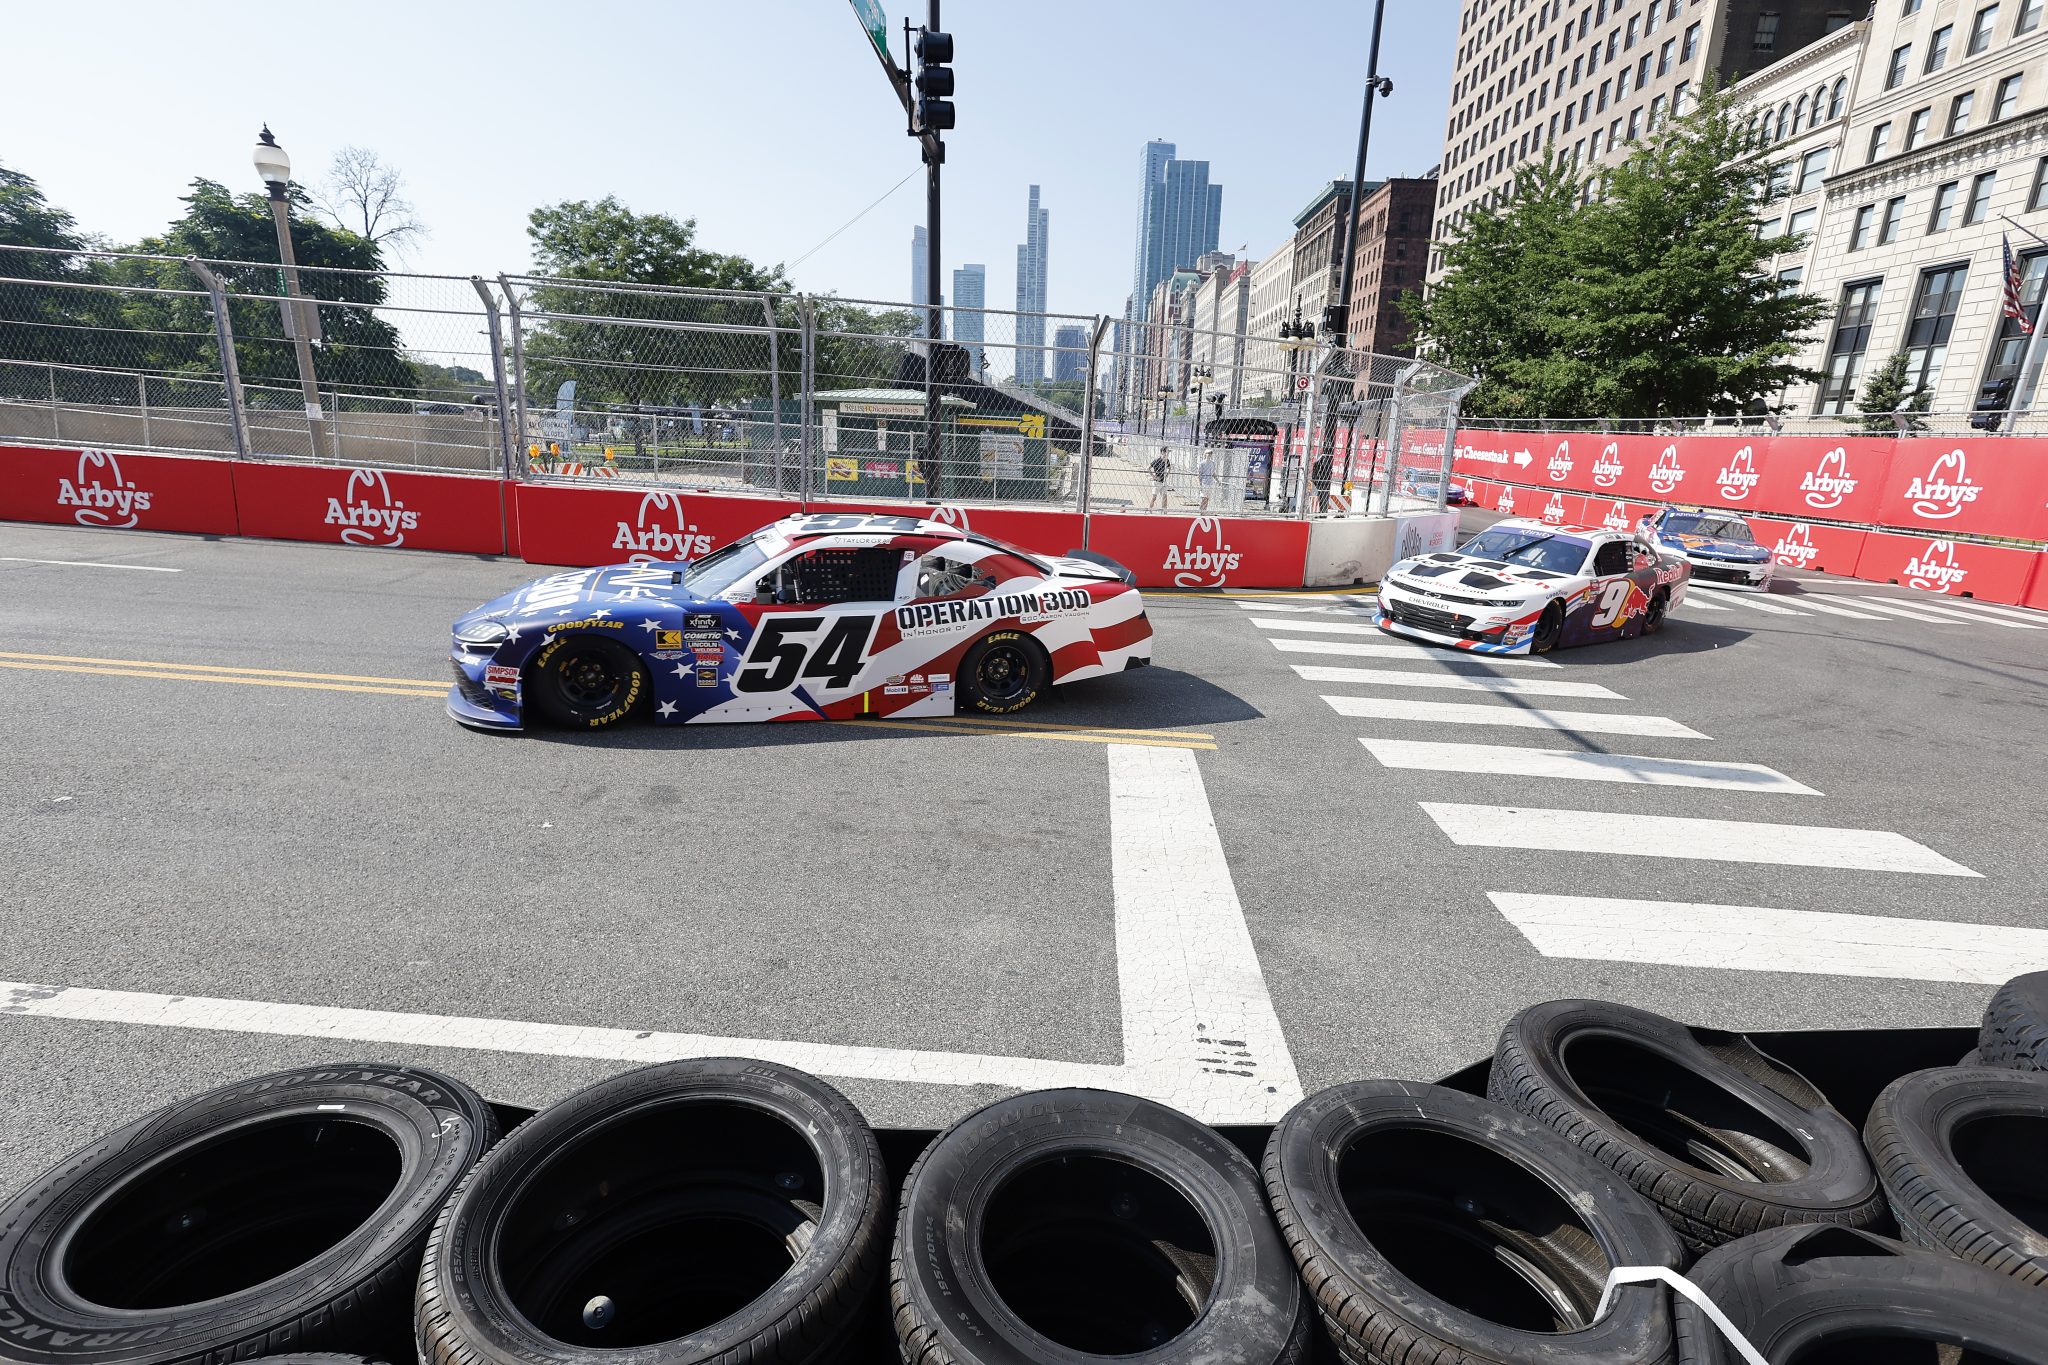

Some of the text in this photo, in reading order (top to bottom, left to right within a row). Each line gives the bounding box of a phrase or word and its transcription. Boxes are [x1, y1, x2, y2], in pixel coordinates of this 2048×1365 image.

[1463, 445, 1509, 464] Cheesesteak
[1546, 454, 1573, 474] Arby's
[1591, 459, 1625, 479] Arby's
[1648, 463, 1687, 487] Arby's
[1716, 467, 1760, 487] Arby's
[1800, 470, 1858, 495] Arby's
[1904, 477, 1984, 507] Arby's
[57, 478, 153, 515] Arby's
[323, 497, 421, 537] Arby's
[1543, 504, 1566, 518] Arby's
[1602, 514, 1630, 531] Arby's
[612, 522, 716, 560] Arby's
[1773, 538, 1820, 562] Arby's
[1162, 544, 1244, 576] Arby's
[1903, 555, 1969, 584] Arby's
[899, 590, 1090, 630] OPERATION 300
[1408, 596, 1450, 610] CHEVROLET
[1591, 579, 1630, 629] 9
[547, 617, 624, 633] GOODYEAR
[690, 618, 717, 627] xfinity
[916, 627, 951, 636] HONOR
[987, 632, 1020, 644] EAGLE
[537, 637, 567, 668] EAGLE
[736, 615, 876, 693] 54
[487, 666, 519, 676] SIMPSON
[454, 1217, 468, 1282] 225/45R17
